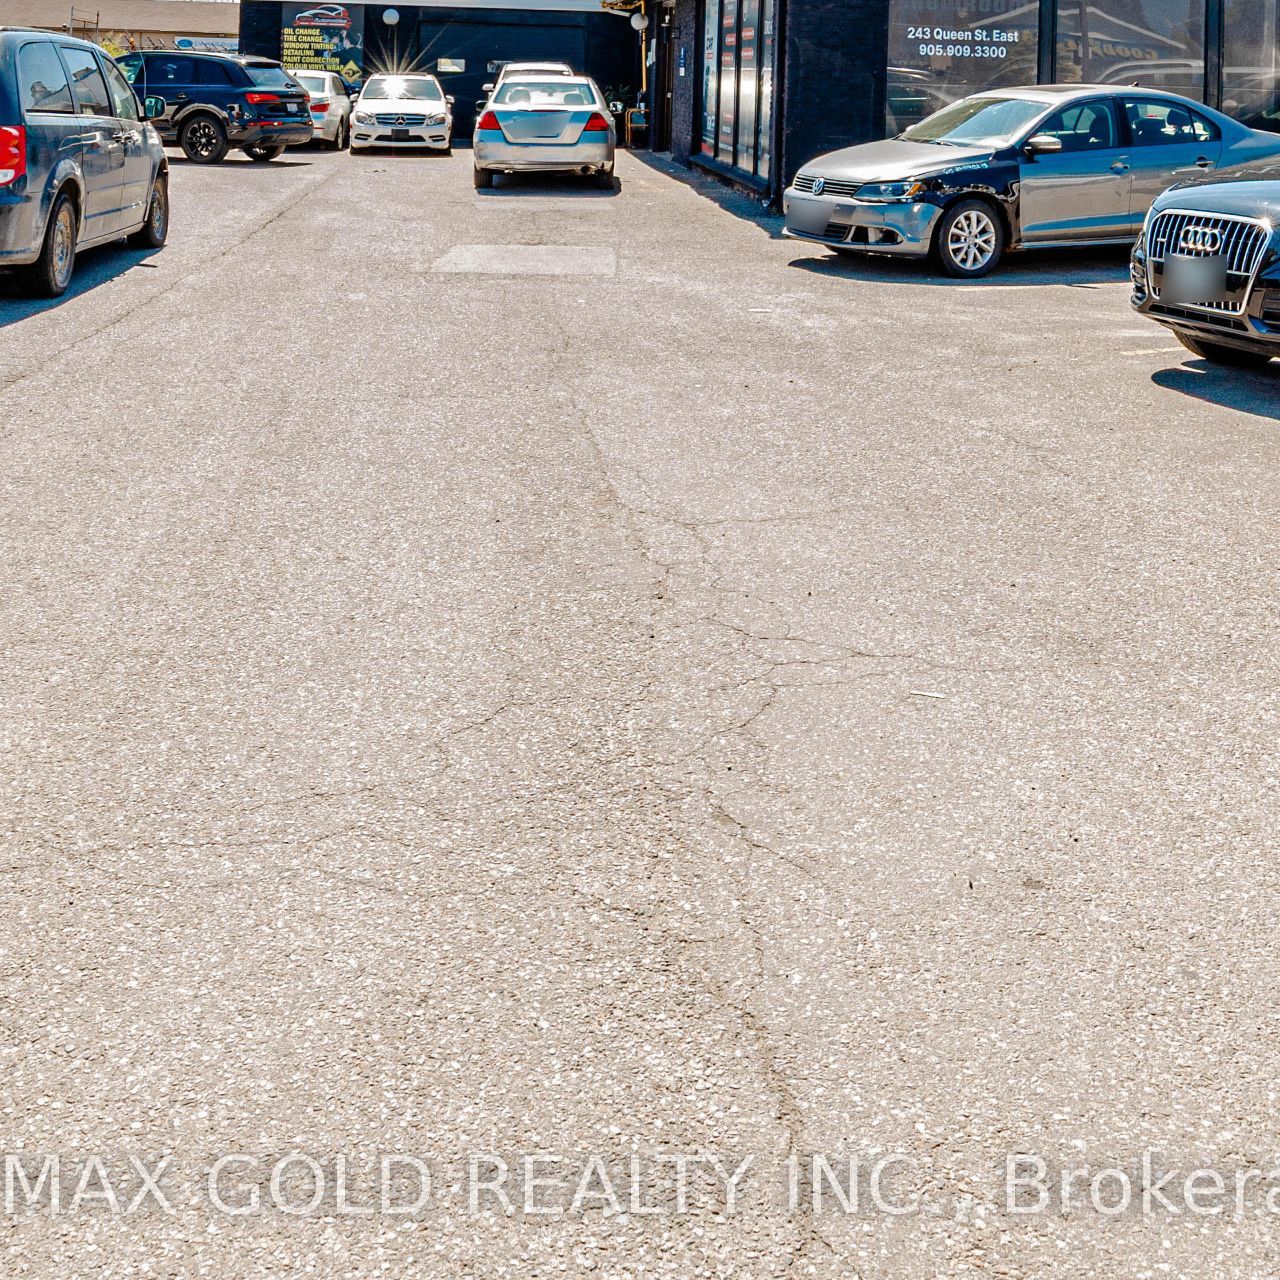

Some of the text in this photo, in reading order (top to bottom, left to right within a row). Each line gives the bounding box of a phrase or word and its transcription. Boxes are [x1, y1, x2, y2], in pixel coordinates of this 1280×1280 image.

[907, 27, 1019, 42] 243 Queen St. East
[919, 44, 1007, 58] 905.909.3300
[326, 64, 345, 72] WRAP
